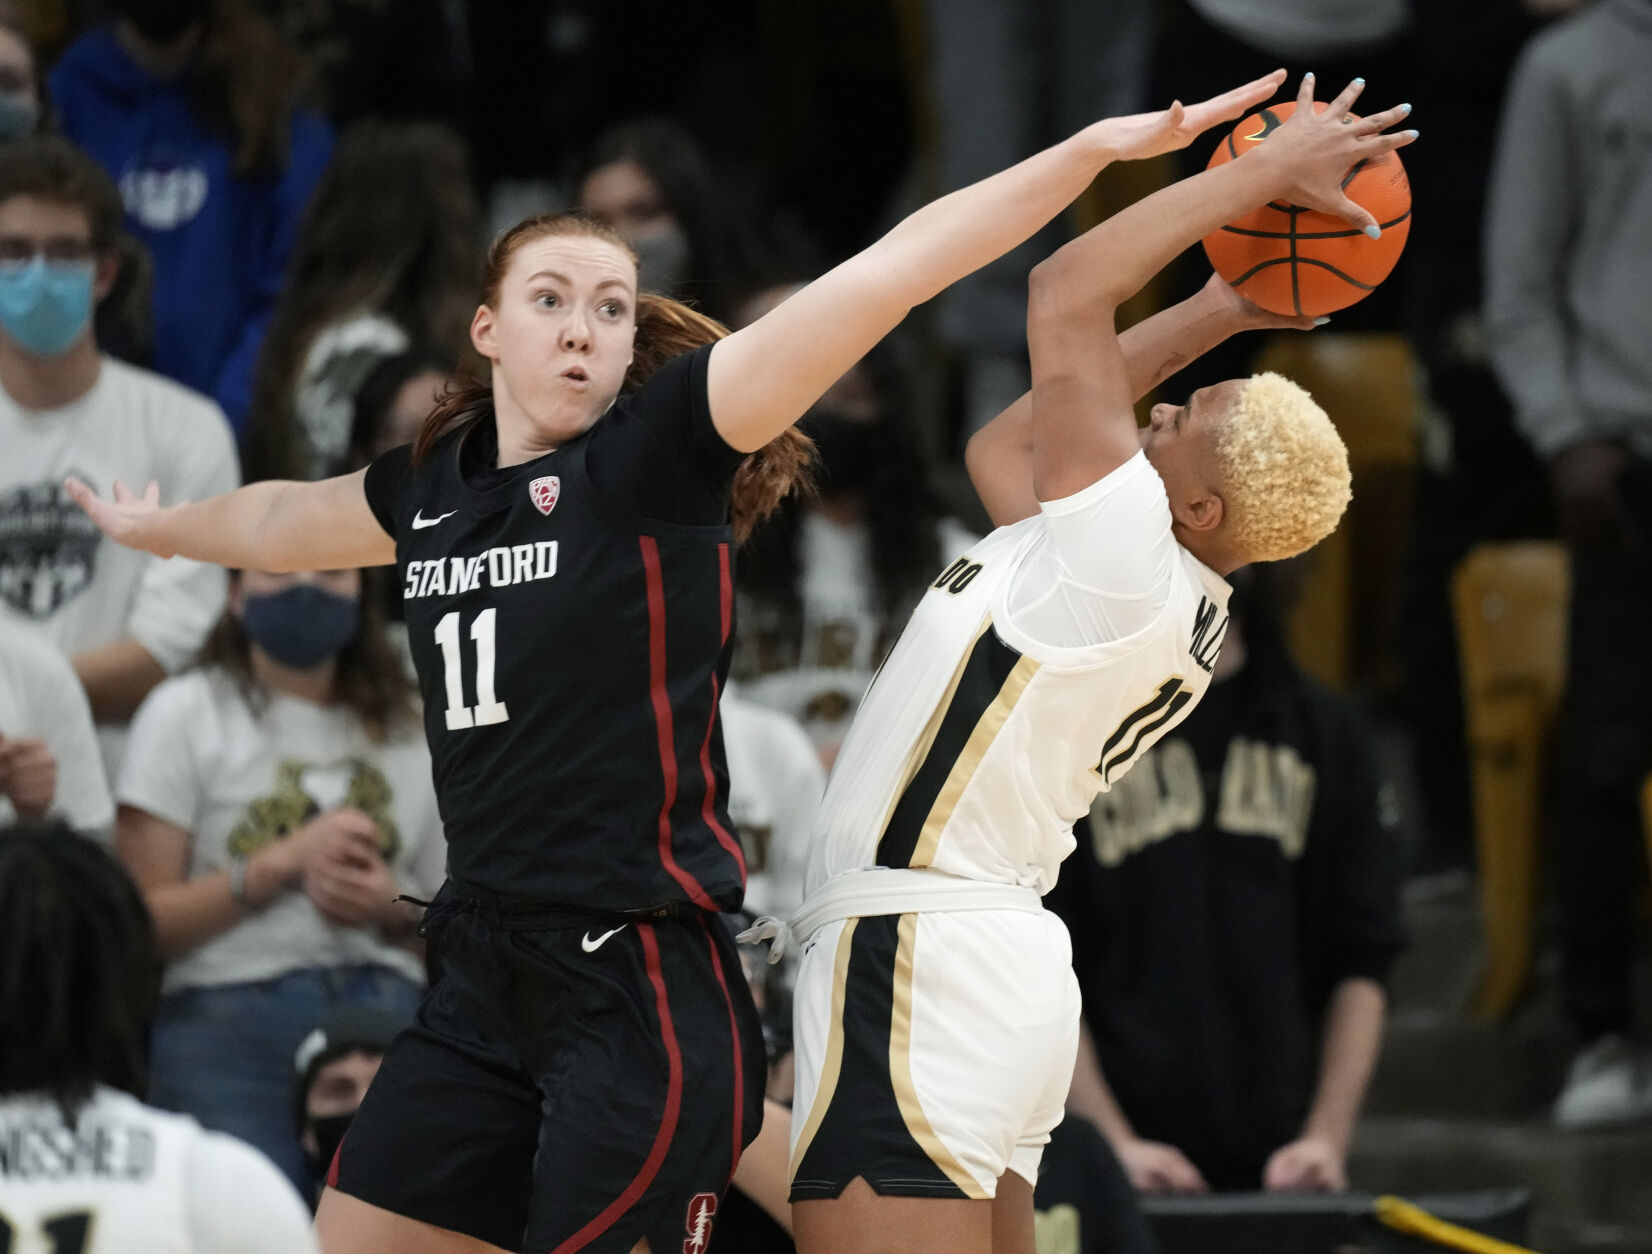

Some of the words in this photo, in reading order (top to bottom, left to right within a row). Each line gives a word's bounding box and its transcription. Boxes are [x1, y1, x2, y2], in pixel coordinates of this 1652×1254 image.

[403, 540, 559, 599] STANFORD
[434, 607, 510, 731] 11
[1090, 674, 1194, 786] 11
